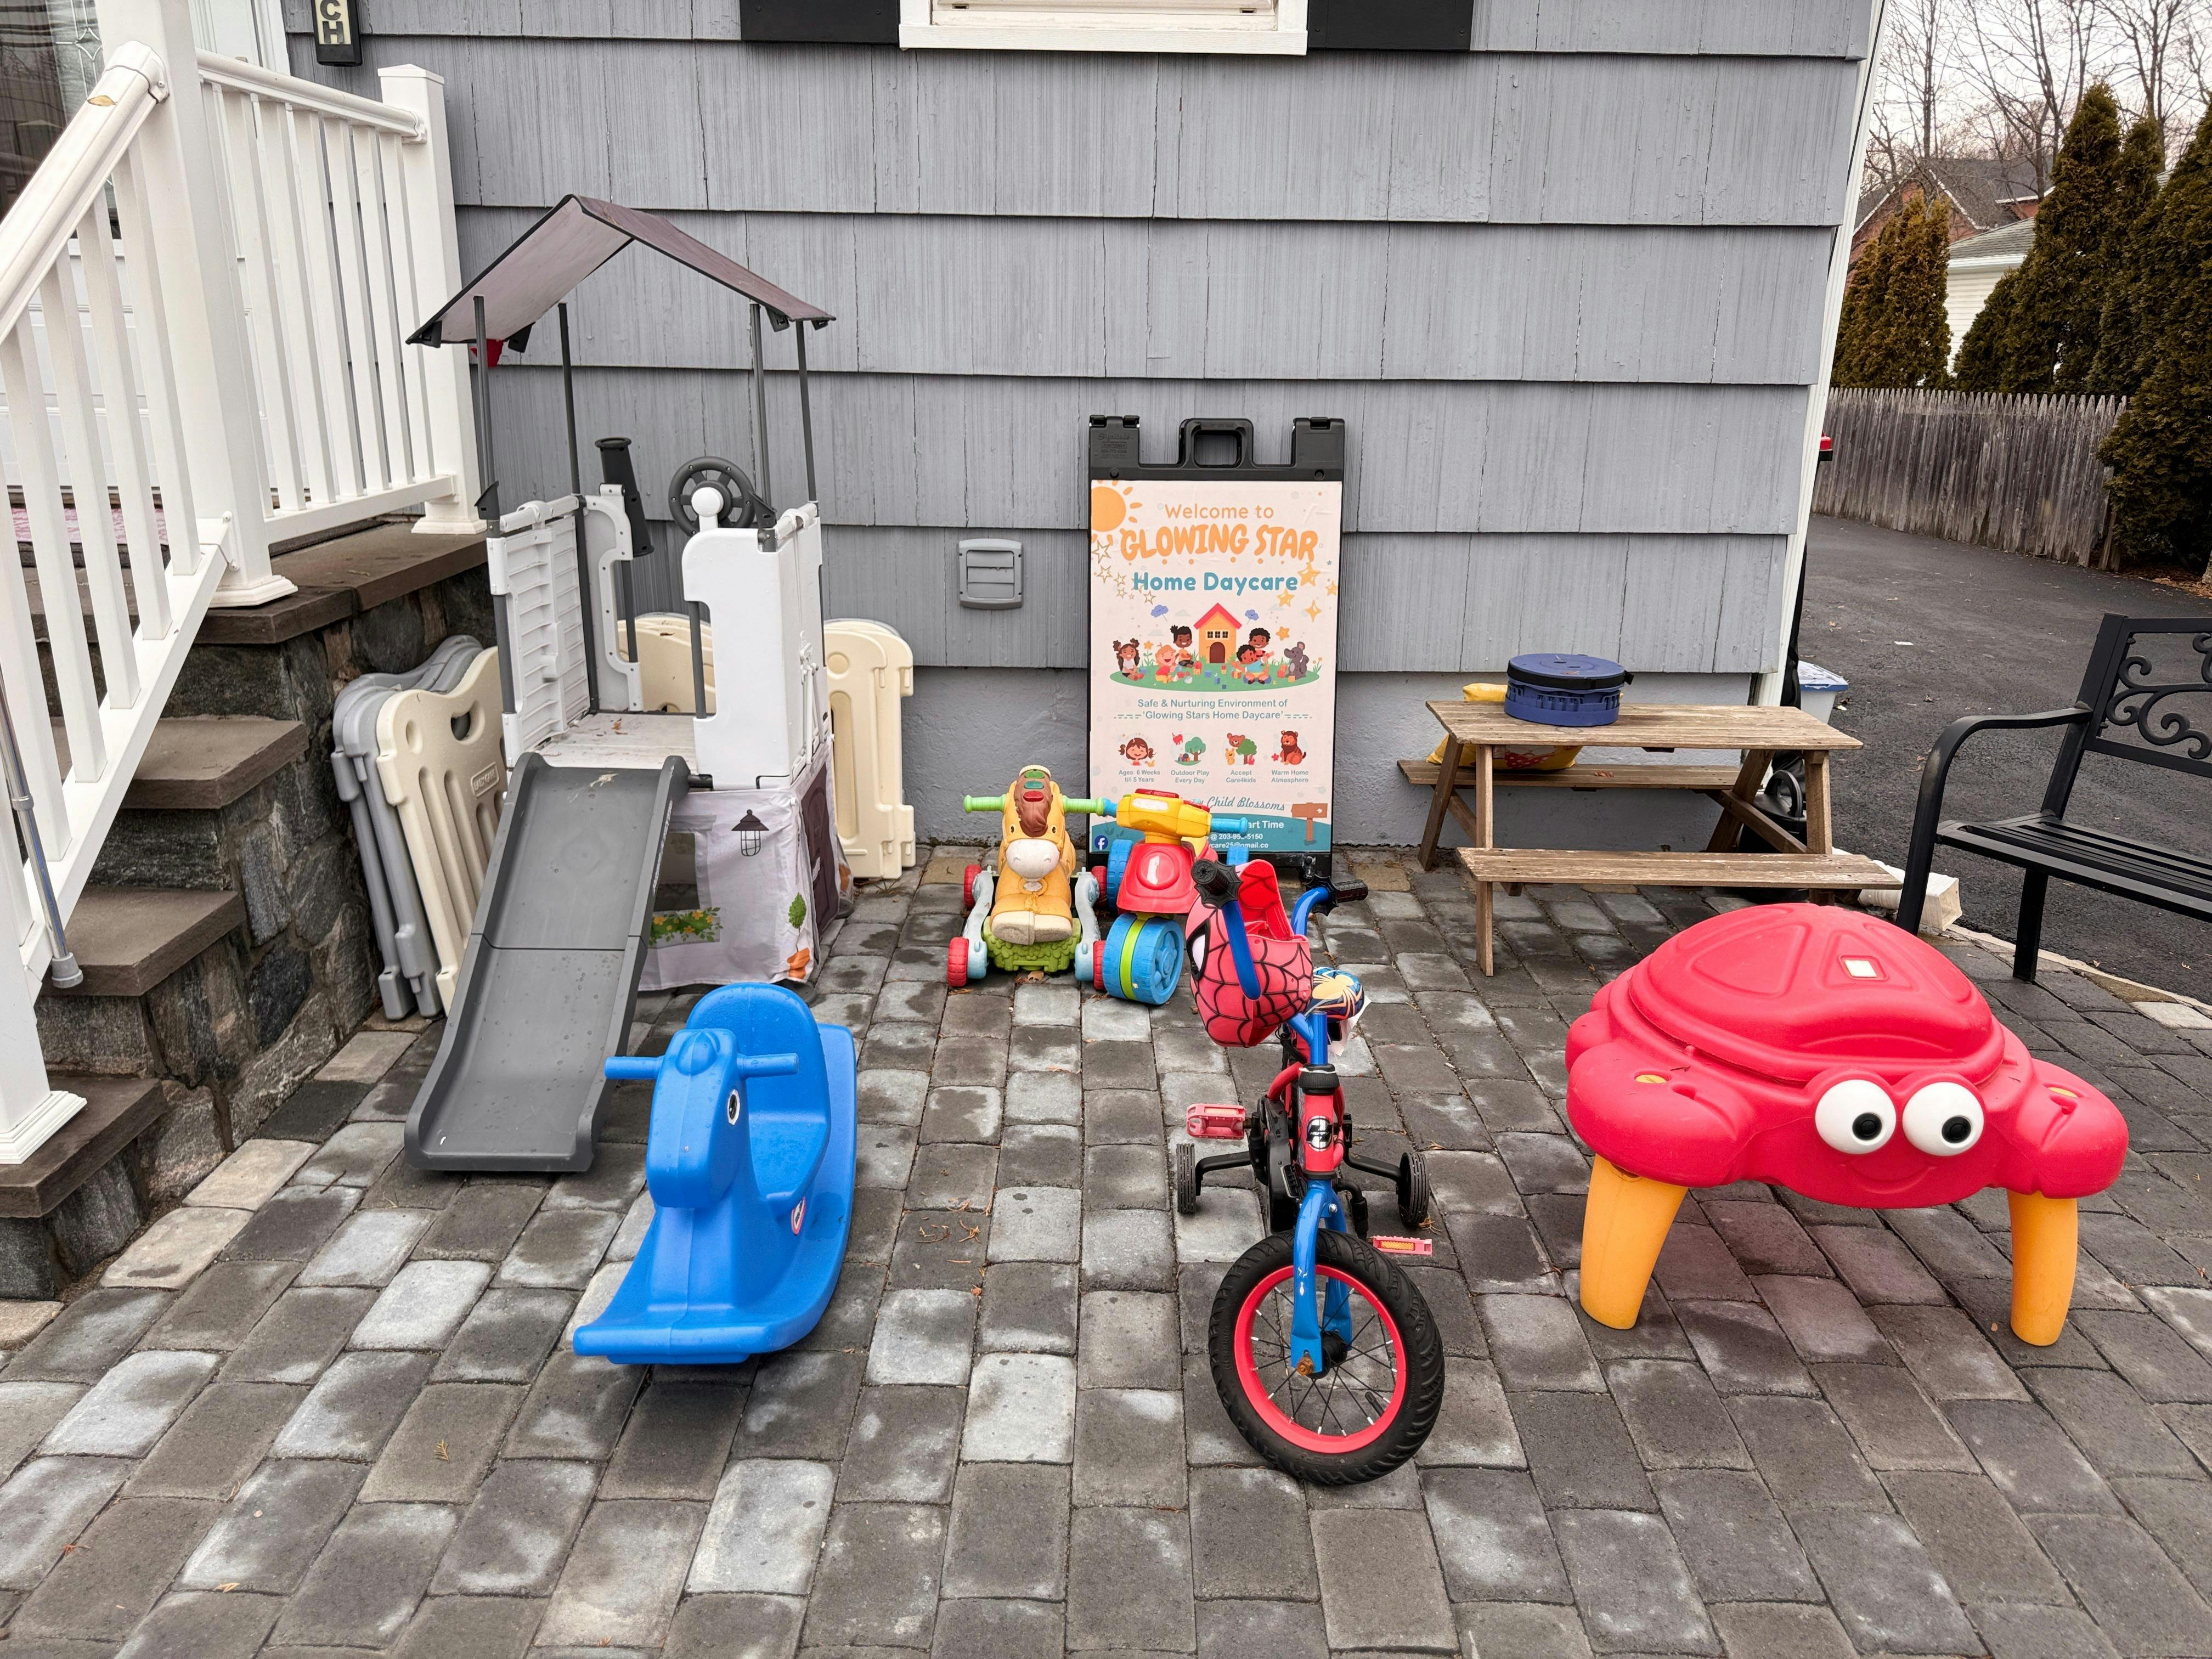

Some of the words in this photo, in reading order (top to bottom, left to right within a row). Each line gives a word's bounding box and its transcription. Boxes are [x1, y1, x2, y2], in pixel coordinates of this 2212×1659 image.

[1165, 503, 1249, 518] Welcome
[1255, 505, 1274, 518] to
[1119, 523, 1249, 561] GLOWING
[1254, 524, 1318, 562] STAR
[1133, 572, 1196, 591] Home
[1204, 572, 1298, 596] Daycare
[1137, 699, 1158, 707] Safe
[1161, 699, 1168, 707] &
[1171, 699, 1215, 709] Nurturing
[1278, 699, 1288, 707] of
[1207, 796, 1235, 809] Child
[1237, 797, 1285, 811] Blossoms
